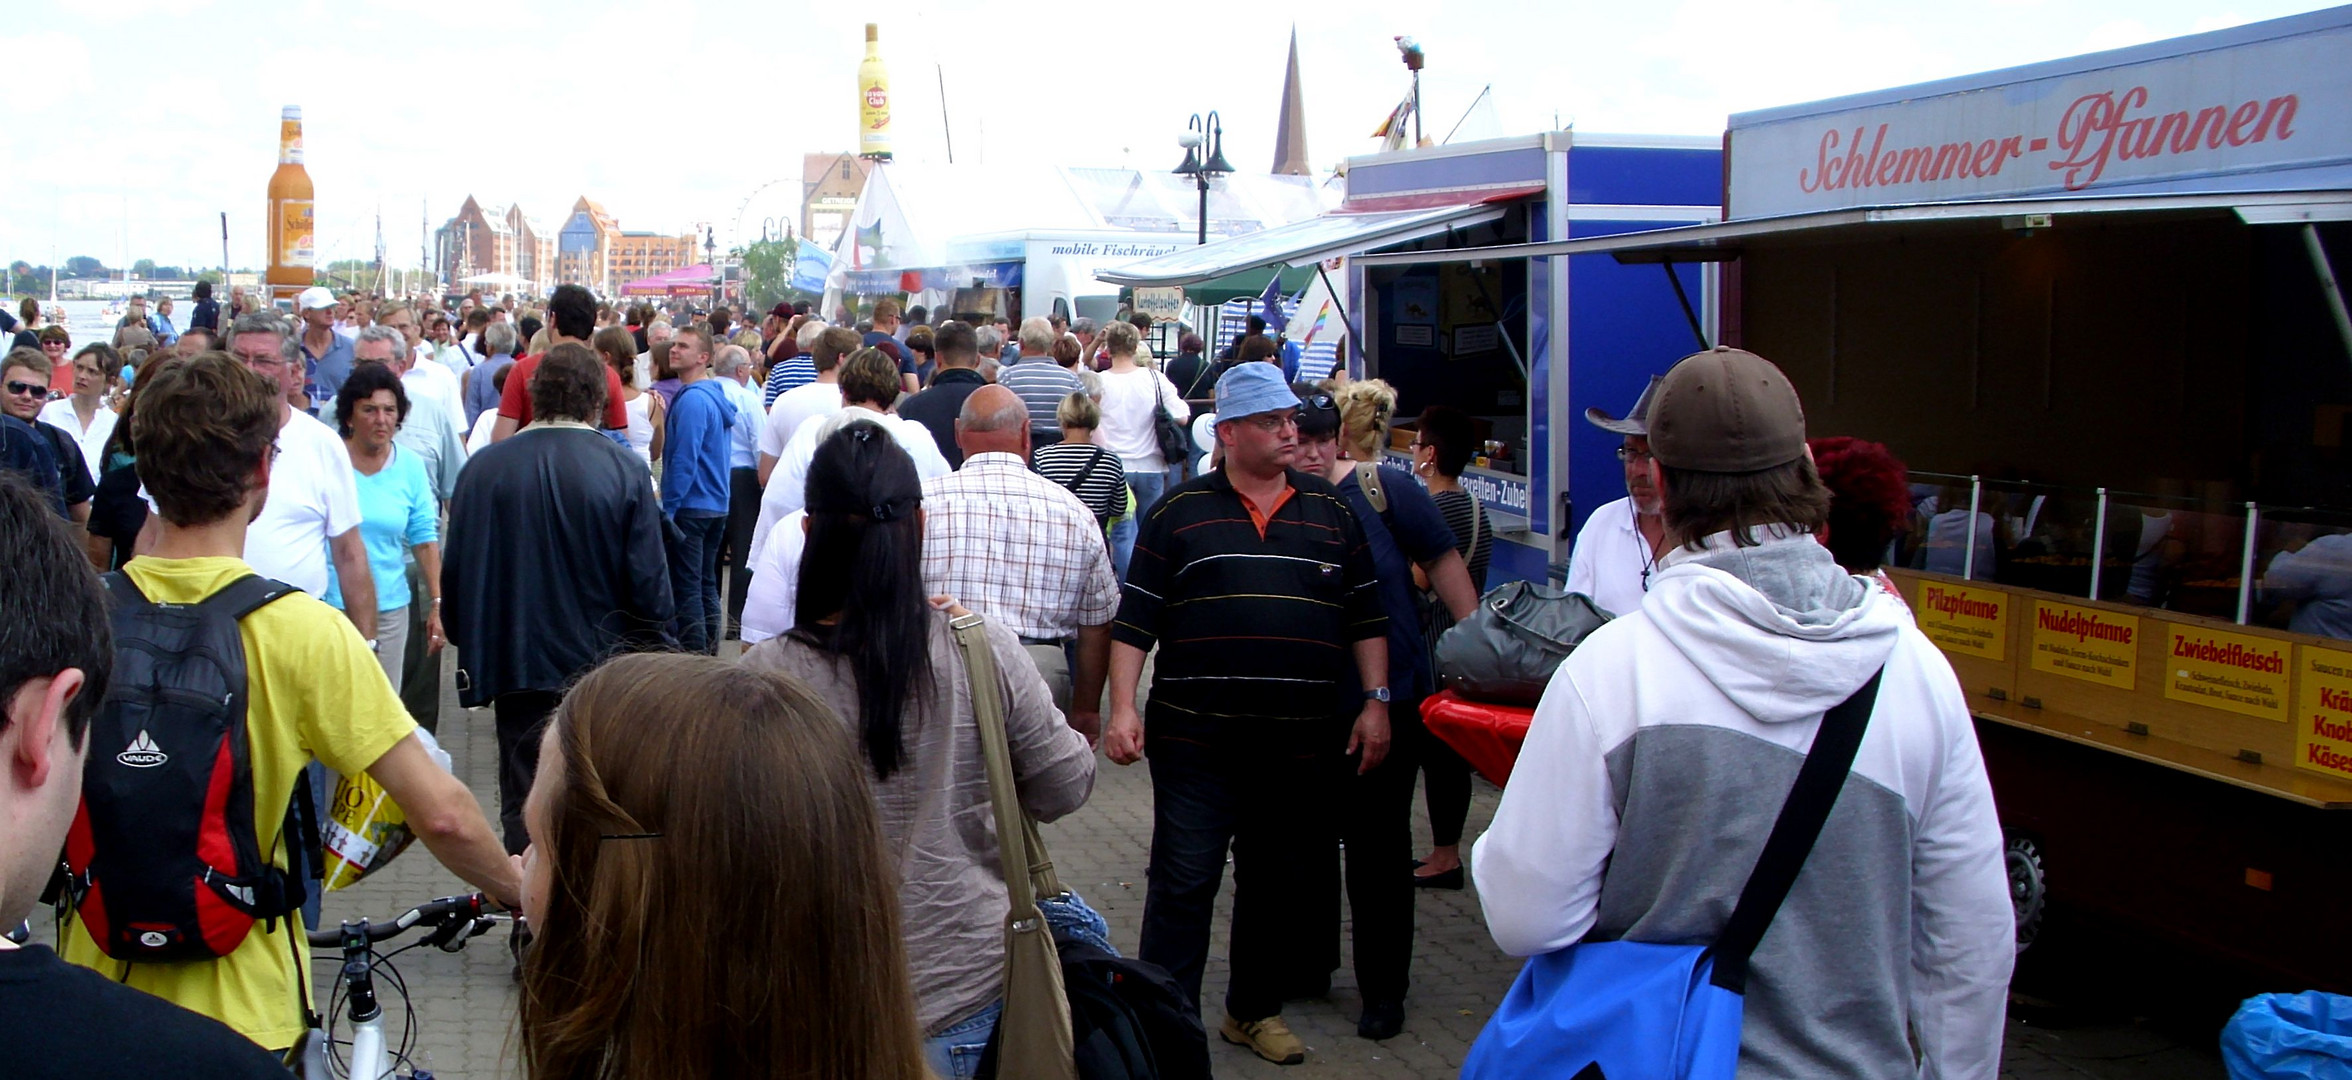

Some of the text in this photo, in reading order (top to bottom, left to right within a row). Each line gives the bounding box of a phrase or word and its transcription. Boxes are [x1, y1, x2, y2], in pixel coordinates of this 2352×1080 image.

[1052, 244, 1099, 256] mobile
[1926, 587, 1998, 621] Pilzpfanne
[2038, 607, 2132, 644] Nudelpfanne
[2174, 634, 2282, 674] Zwiebelfleisch
[122, 754, 163, 762] VAUDE
